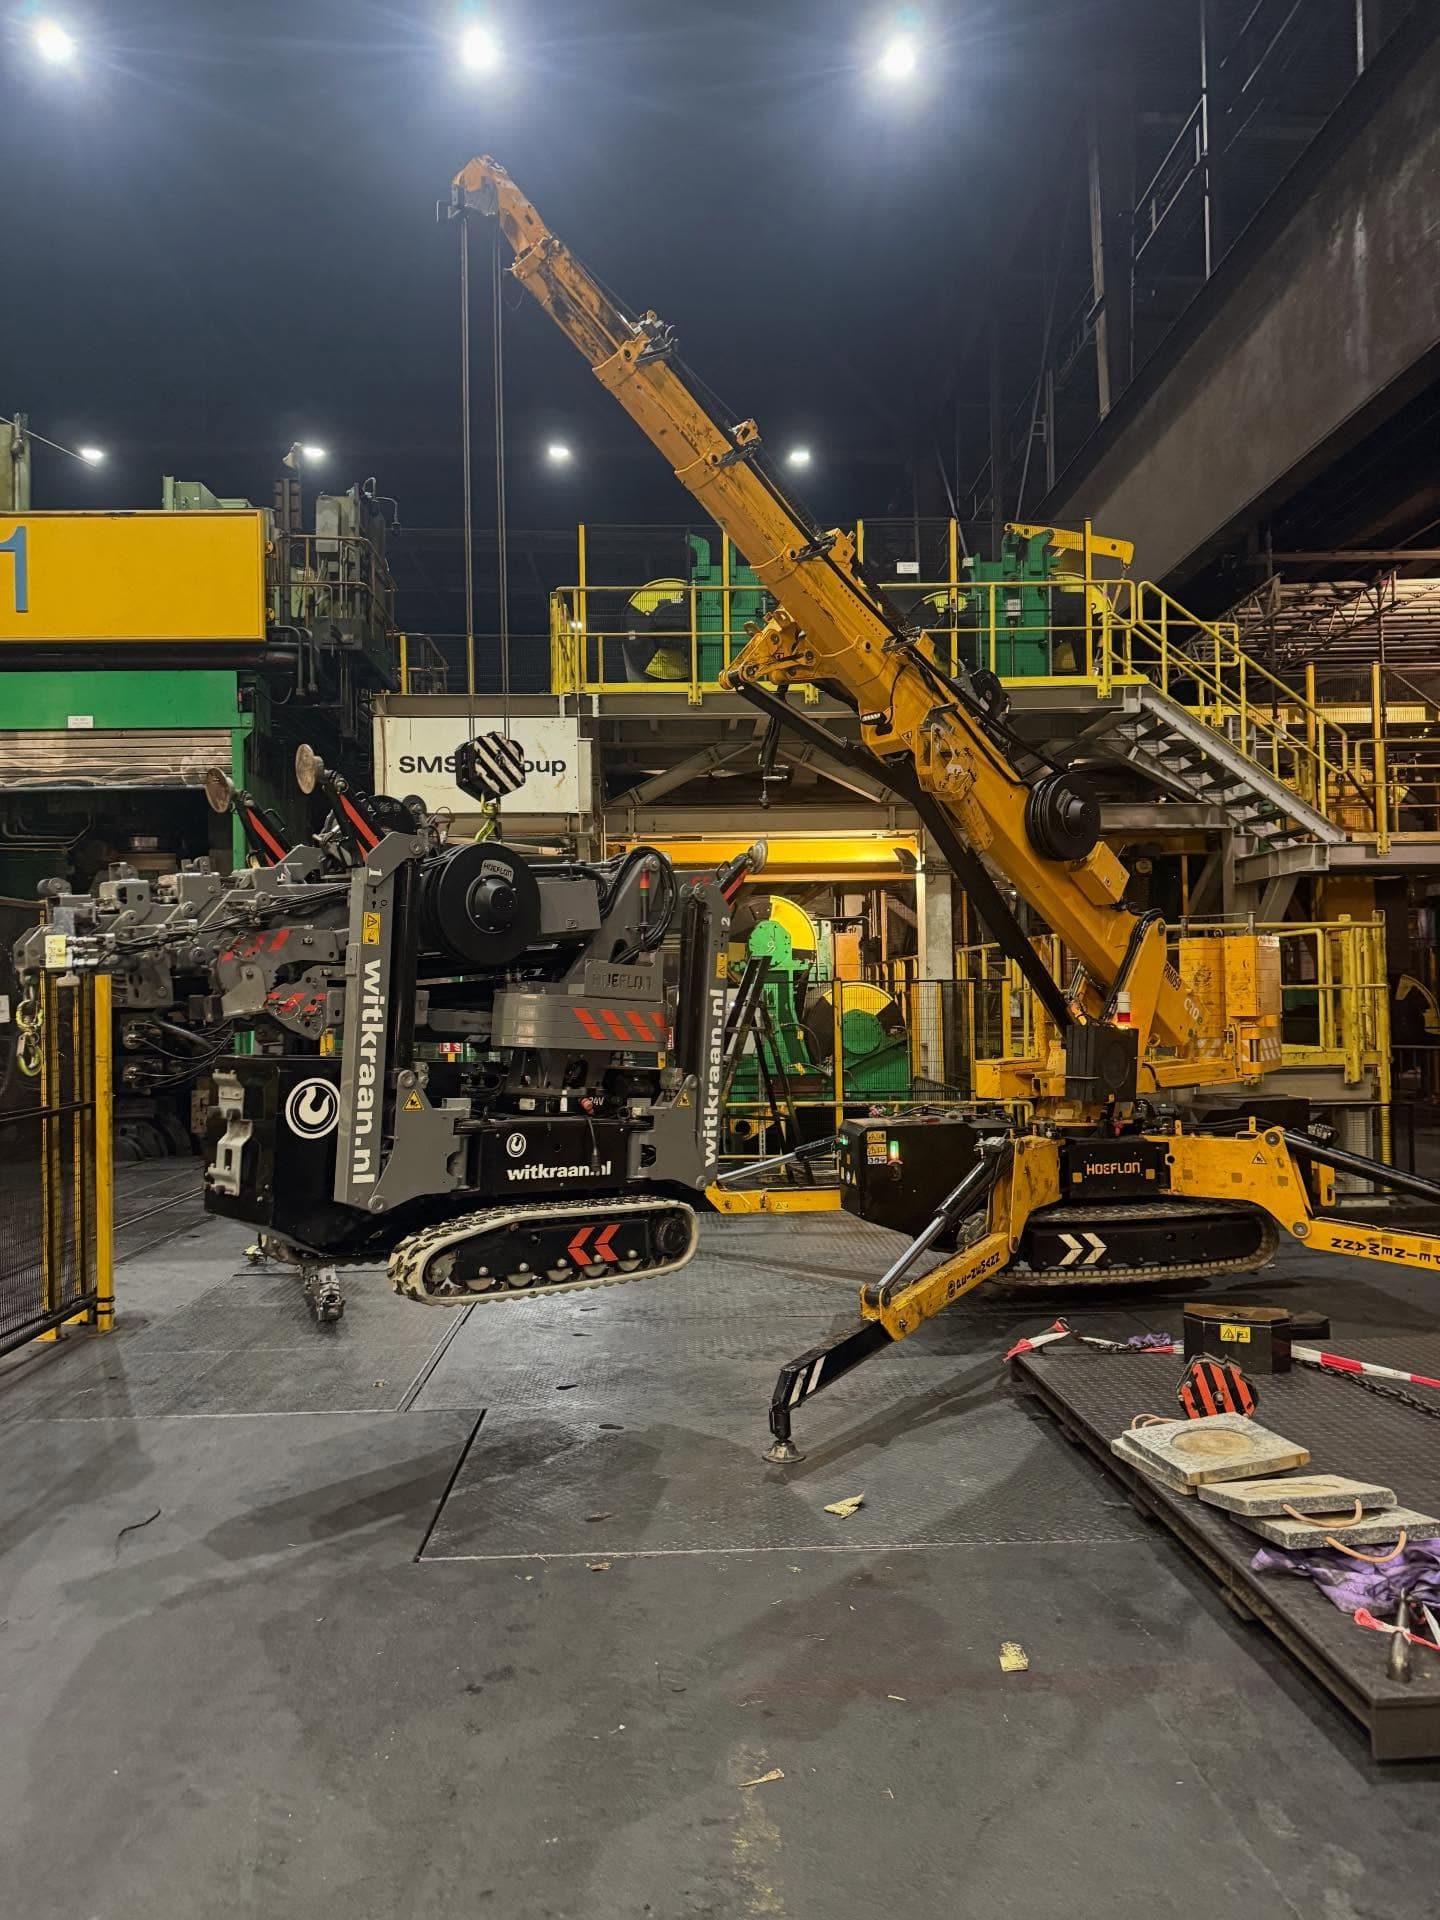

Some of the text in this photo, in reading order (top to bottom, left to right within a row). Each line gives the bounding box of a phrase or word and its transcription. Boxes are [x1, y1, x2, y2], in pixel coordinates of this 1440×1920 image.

[721, 916, 731, 927] 2
[352, 959, 386, 1184] witkraan.nl
[702, 989, 724, 1168] witkraan.nl
[506, 1160, 612, 1181] witkraan.nl
[1086, 1161, 1141, 1175] HOEFLON
